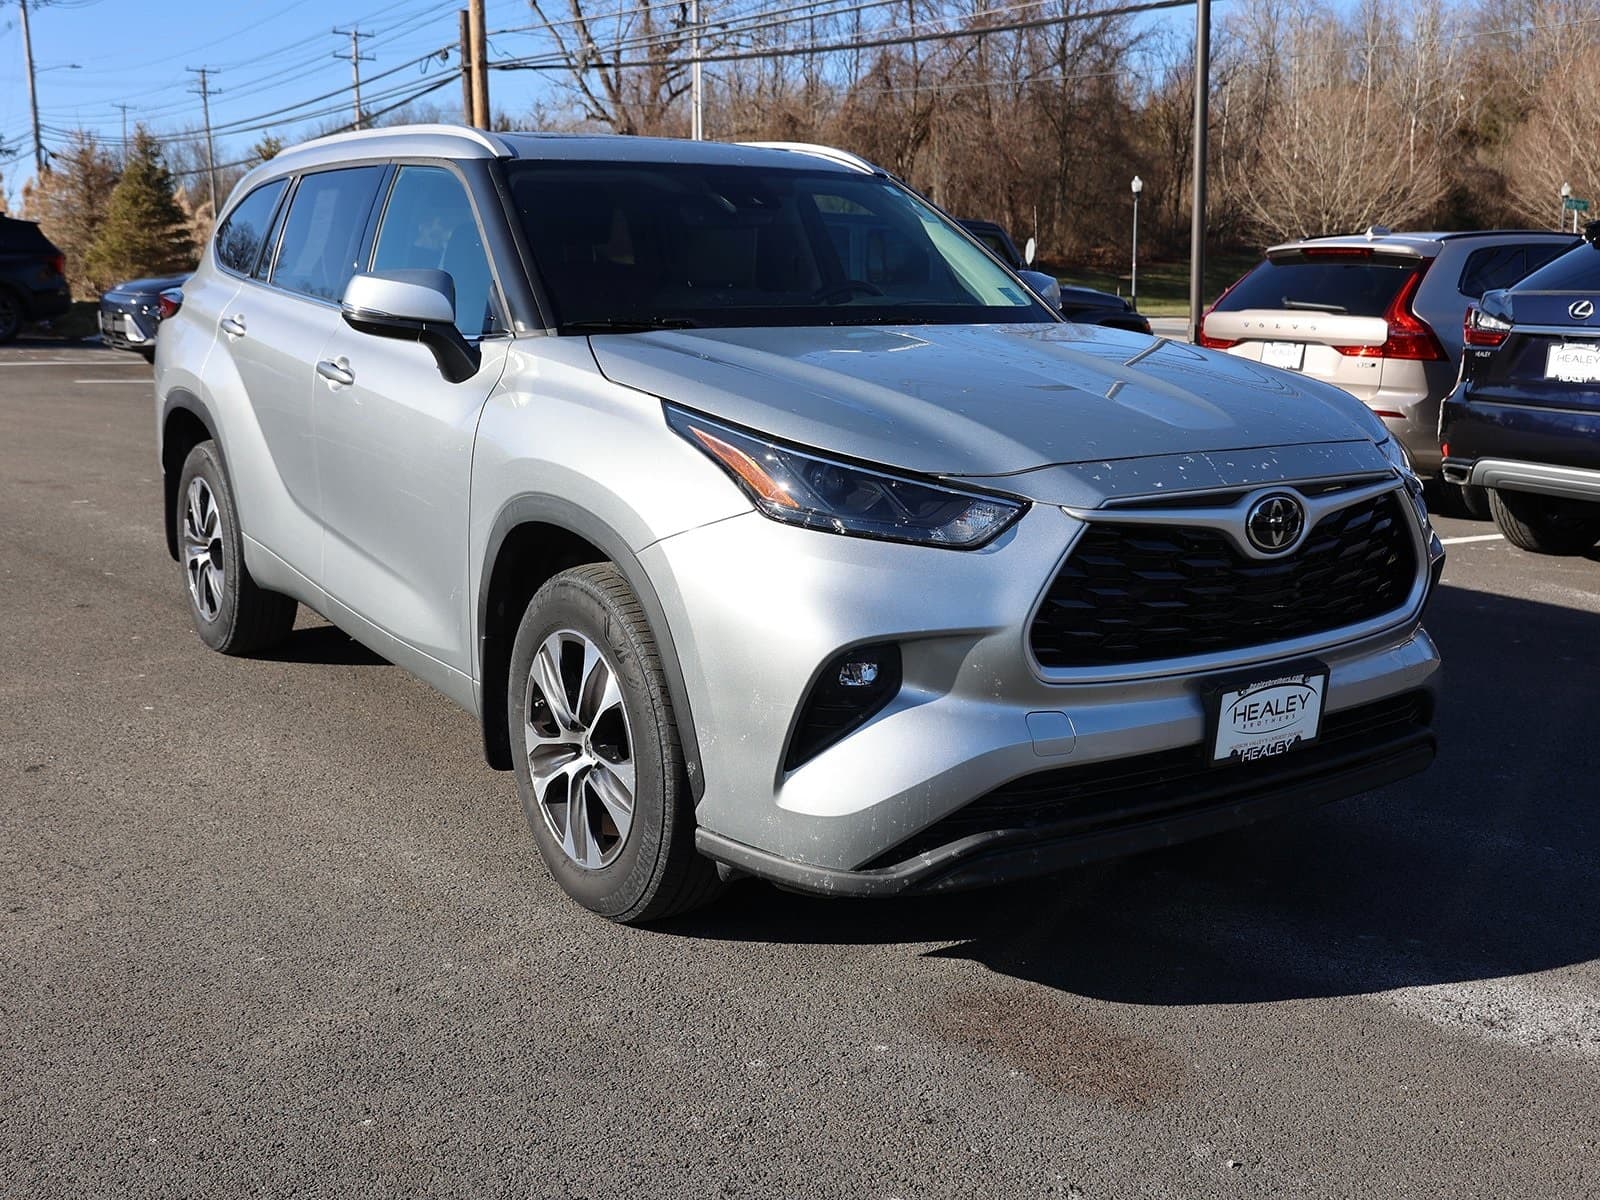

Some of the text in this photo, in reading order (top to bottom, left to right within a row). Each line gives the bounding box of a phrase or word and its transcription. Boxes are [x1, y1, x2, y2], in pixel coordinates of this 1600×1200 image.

[1243, 321, 1318, 331] VOLVO
[1557, 353, 1600, 365] HEALEY
[1233, 691, 1311, 724] HEALEY
[1243, 714, 1296, 729] BROTHERS
[1241, 739, 1293, 762] HEALEY
